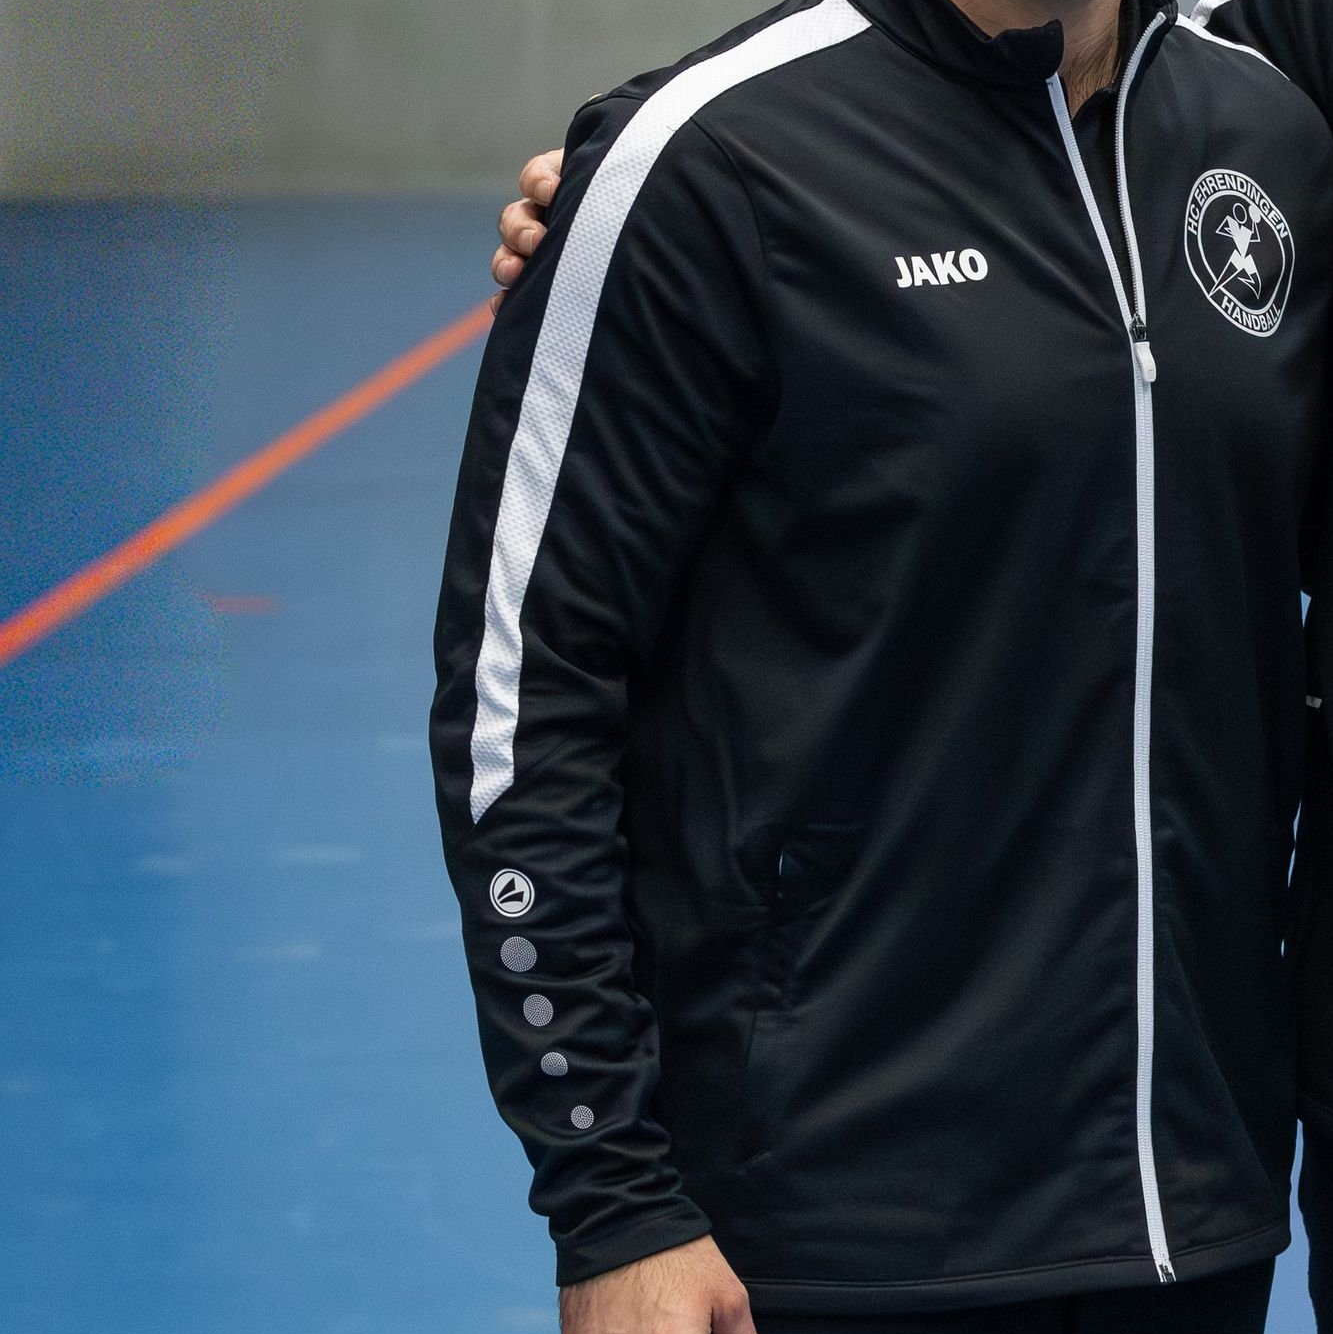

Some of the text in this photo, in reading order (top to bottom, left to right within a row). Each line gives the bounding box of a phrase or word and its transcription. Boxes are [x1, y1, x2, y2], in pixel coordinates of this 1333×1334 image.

[1187, 174, 1289, 239] HC EHRENDINGEN
[894, 248, 988, 288] JAKO
[1221, 295, 1281, 332] HANDBALL
